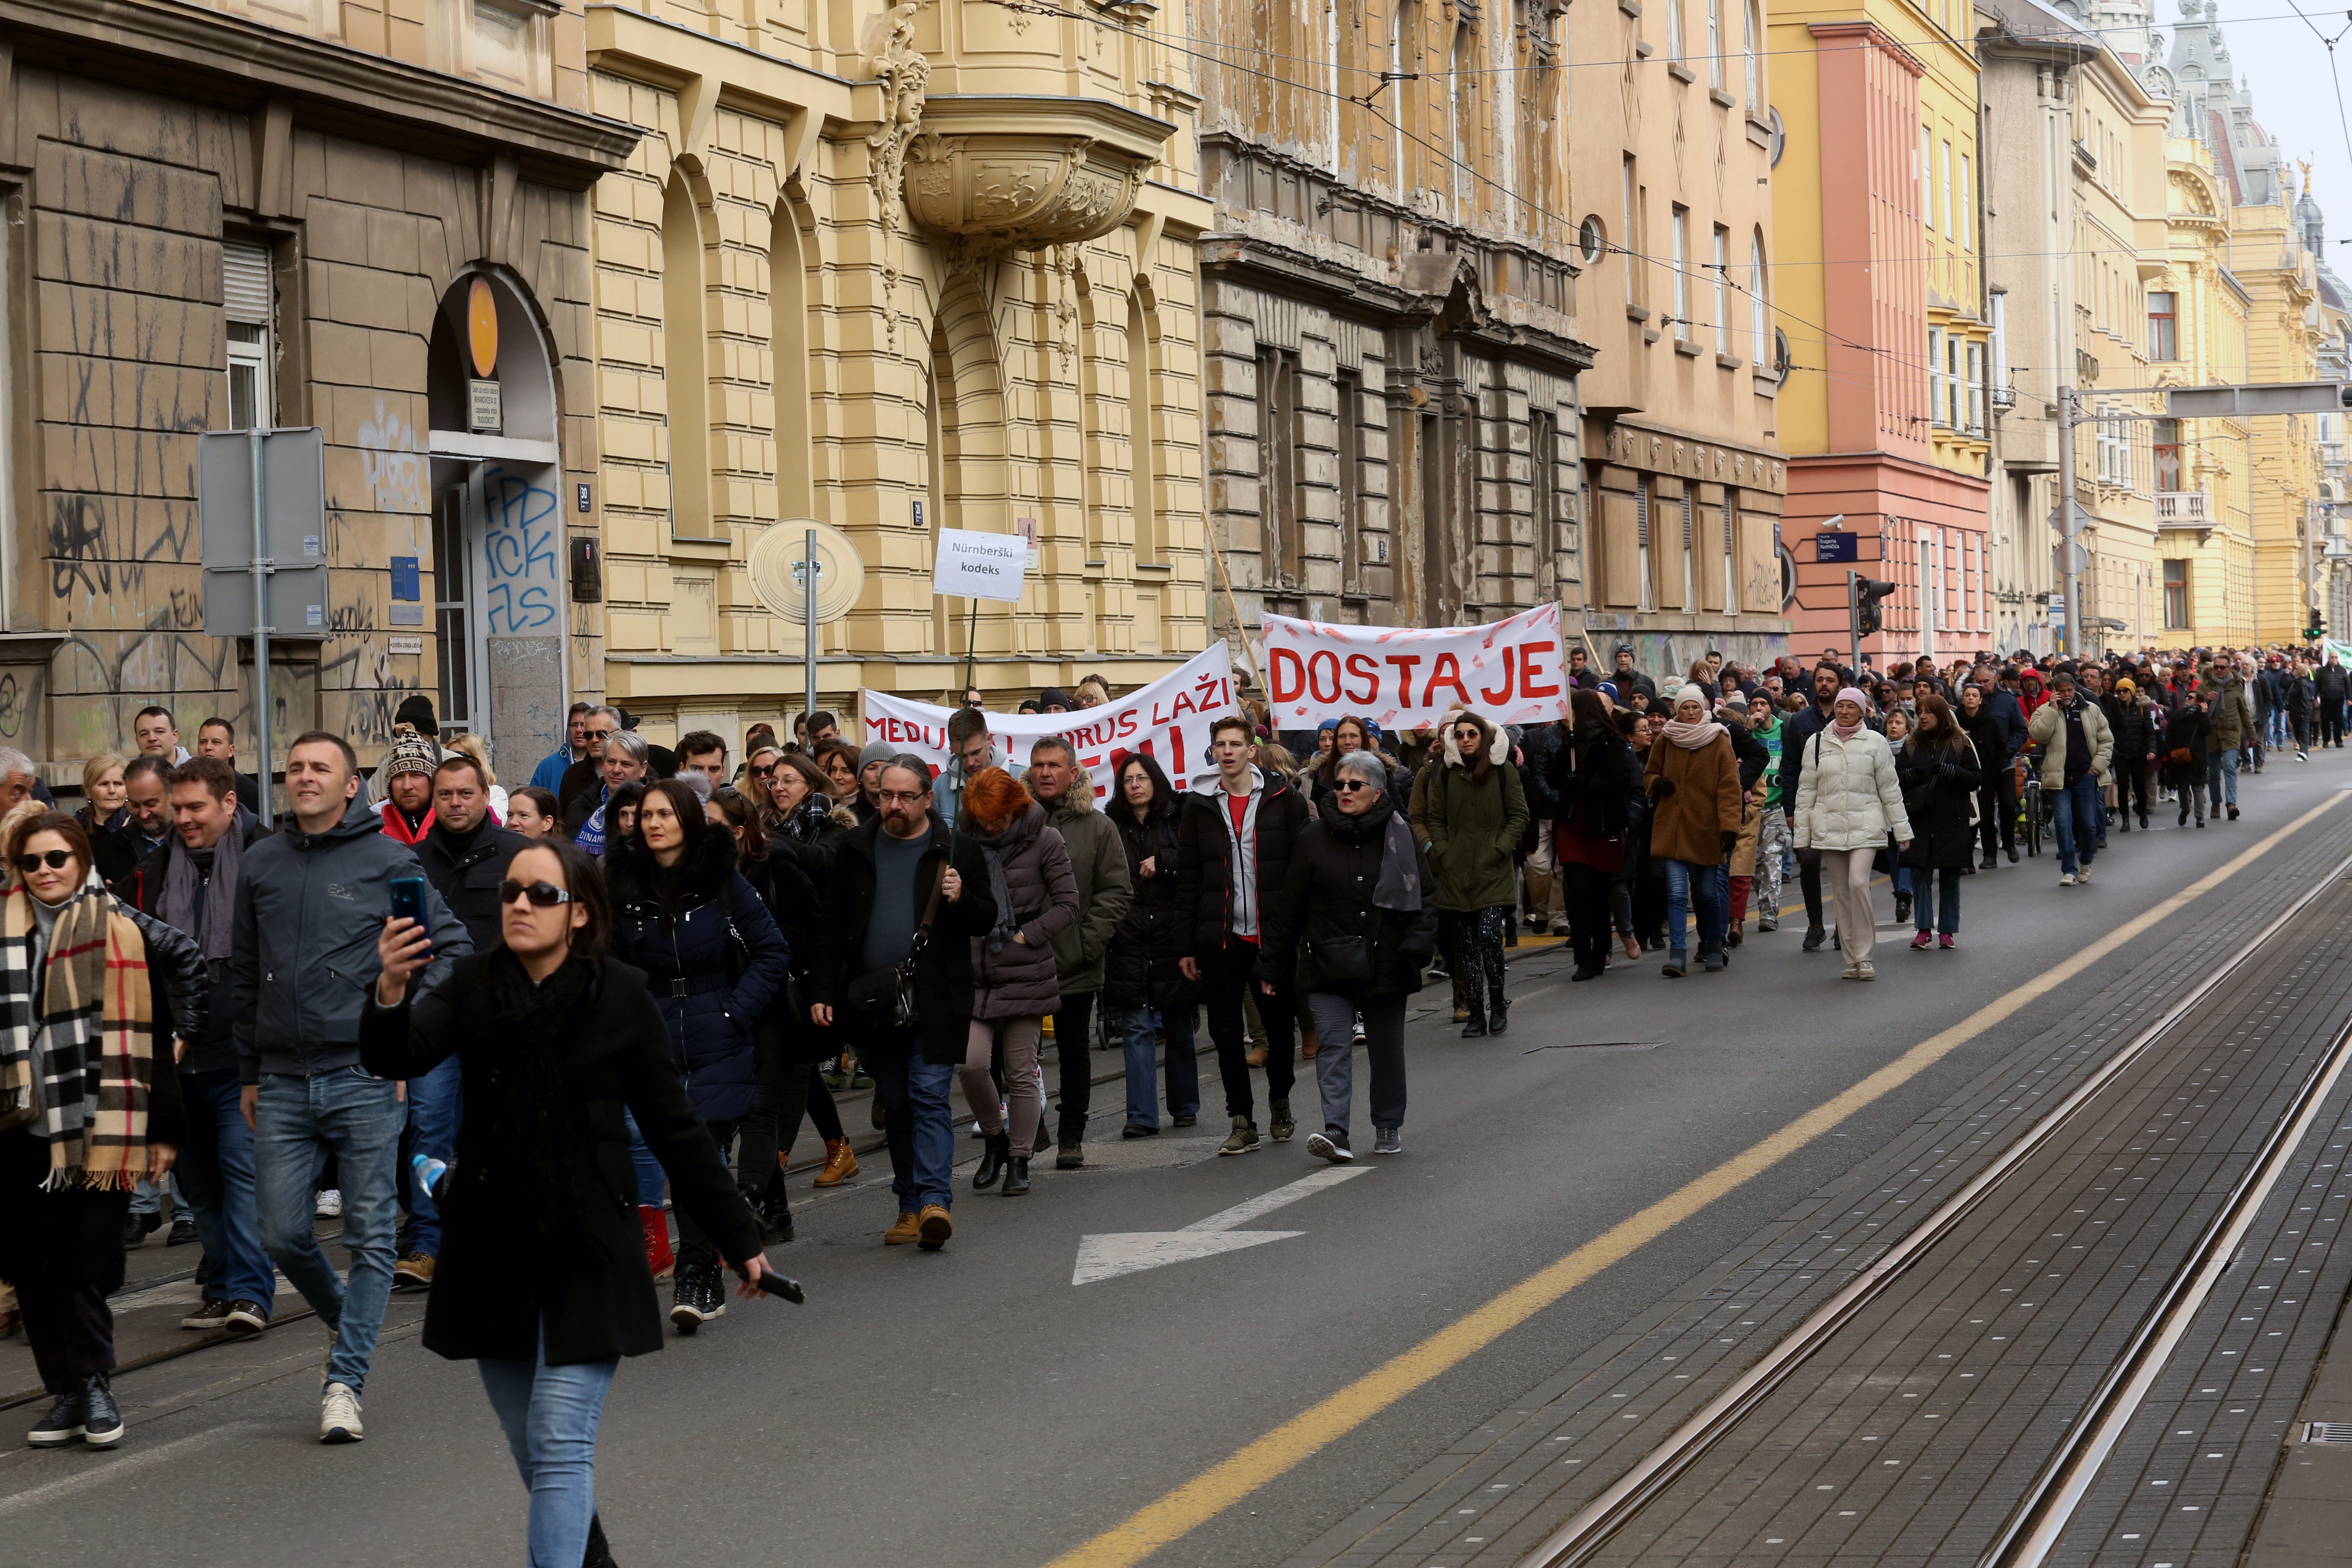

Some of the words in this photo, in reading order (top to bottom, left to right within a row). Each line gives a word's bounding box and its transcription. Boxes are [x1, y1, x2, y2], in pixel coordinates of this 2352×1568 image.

[581, 487, 587, 499] 30
[952, 542, 1013, 558] Nürnberški
[961, 562, 1000, 576] kodeks
[1152, 672, 1230, 726] LAŽI
